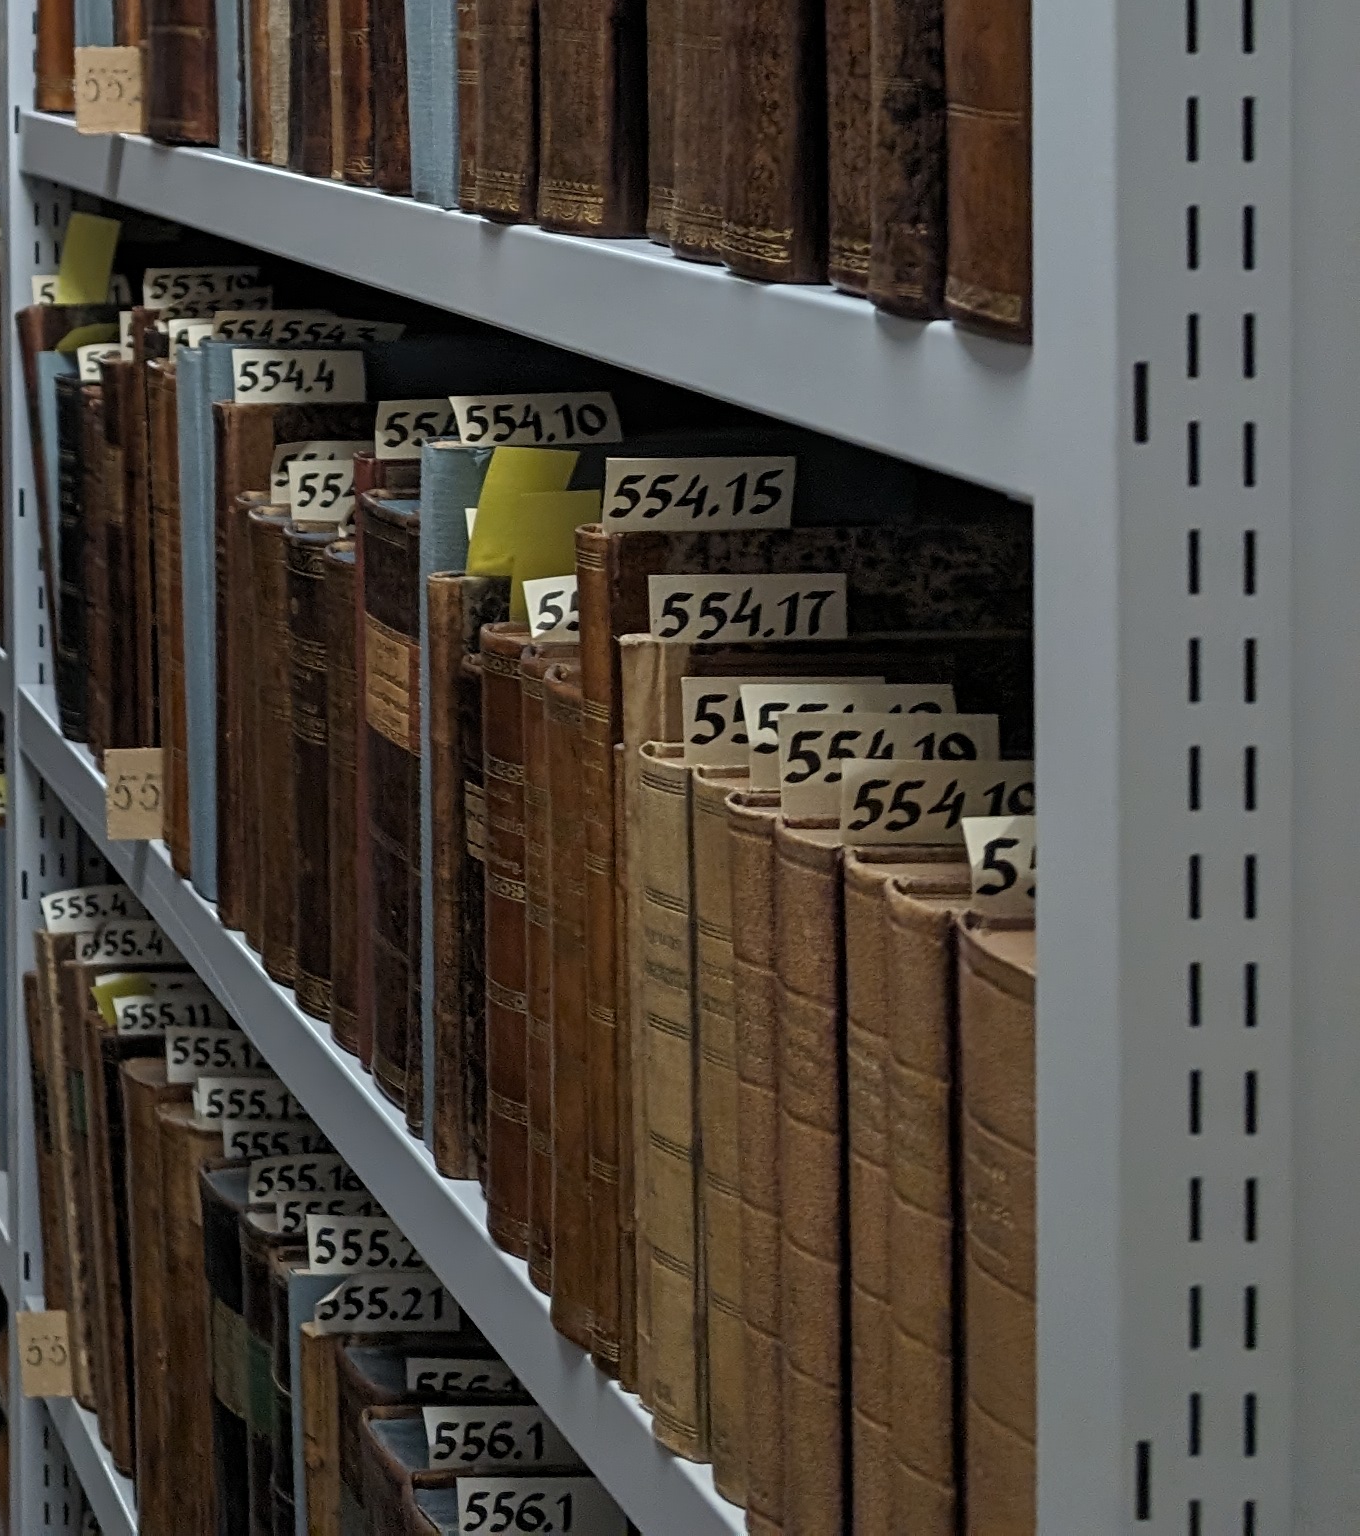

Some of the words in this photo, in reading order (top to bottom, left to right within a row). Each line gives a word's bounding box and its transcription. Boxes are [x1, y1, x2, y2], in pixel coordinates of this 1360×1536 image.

[236, 358, 335, 394] 554.4
[465, 402, 608, 444] 554.10
[608, 469, 785, 520] 554.15
[658, 586, 837, 641] 554.17
[50, 893, 127, 921] 555.4
[433, 1420, 544, 1461] 556.1
[463, 1491, 573, 1533] 556.1
